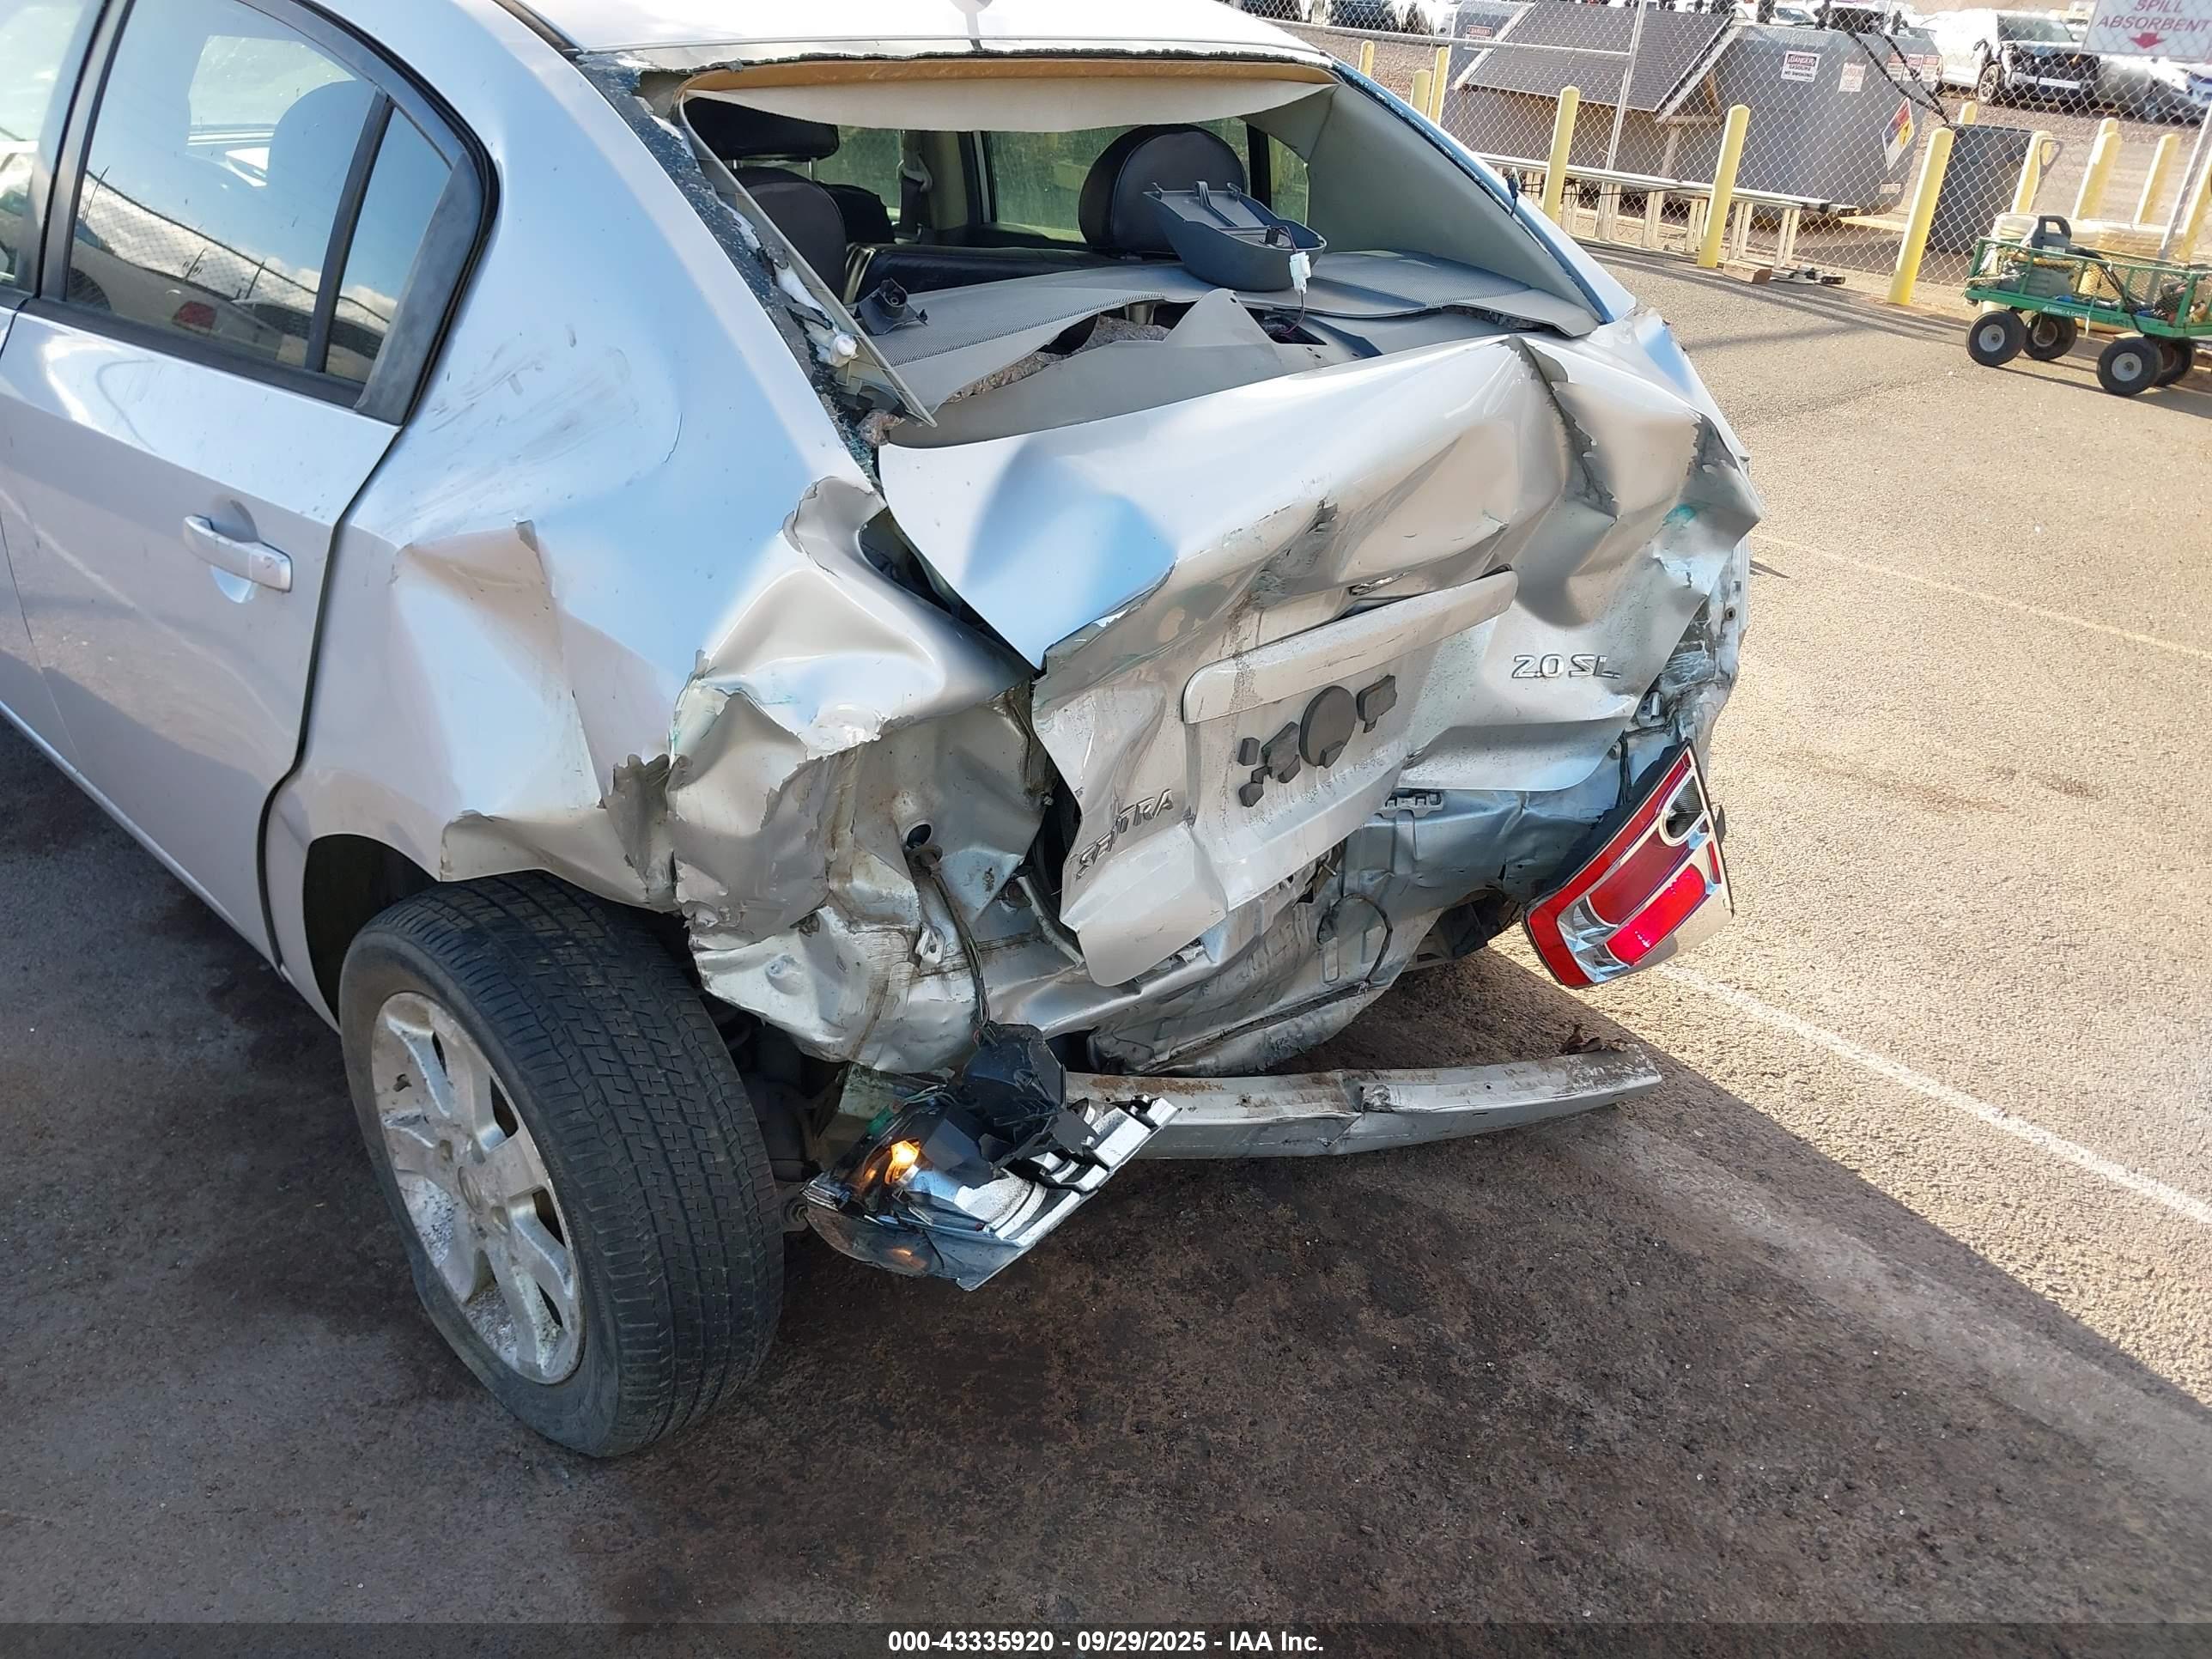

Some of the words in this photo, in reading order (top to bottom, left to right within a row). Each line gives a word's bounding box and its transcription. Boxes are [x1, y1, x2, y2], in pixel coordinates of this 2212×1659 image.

[2134, 0, 2184, 13] SPILL
[2096, 15, 2211, 33] ABSORBENT
[1787, 55, 1815, 65] DANGER
[1569, 653, 1622, 679] SL
